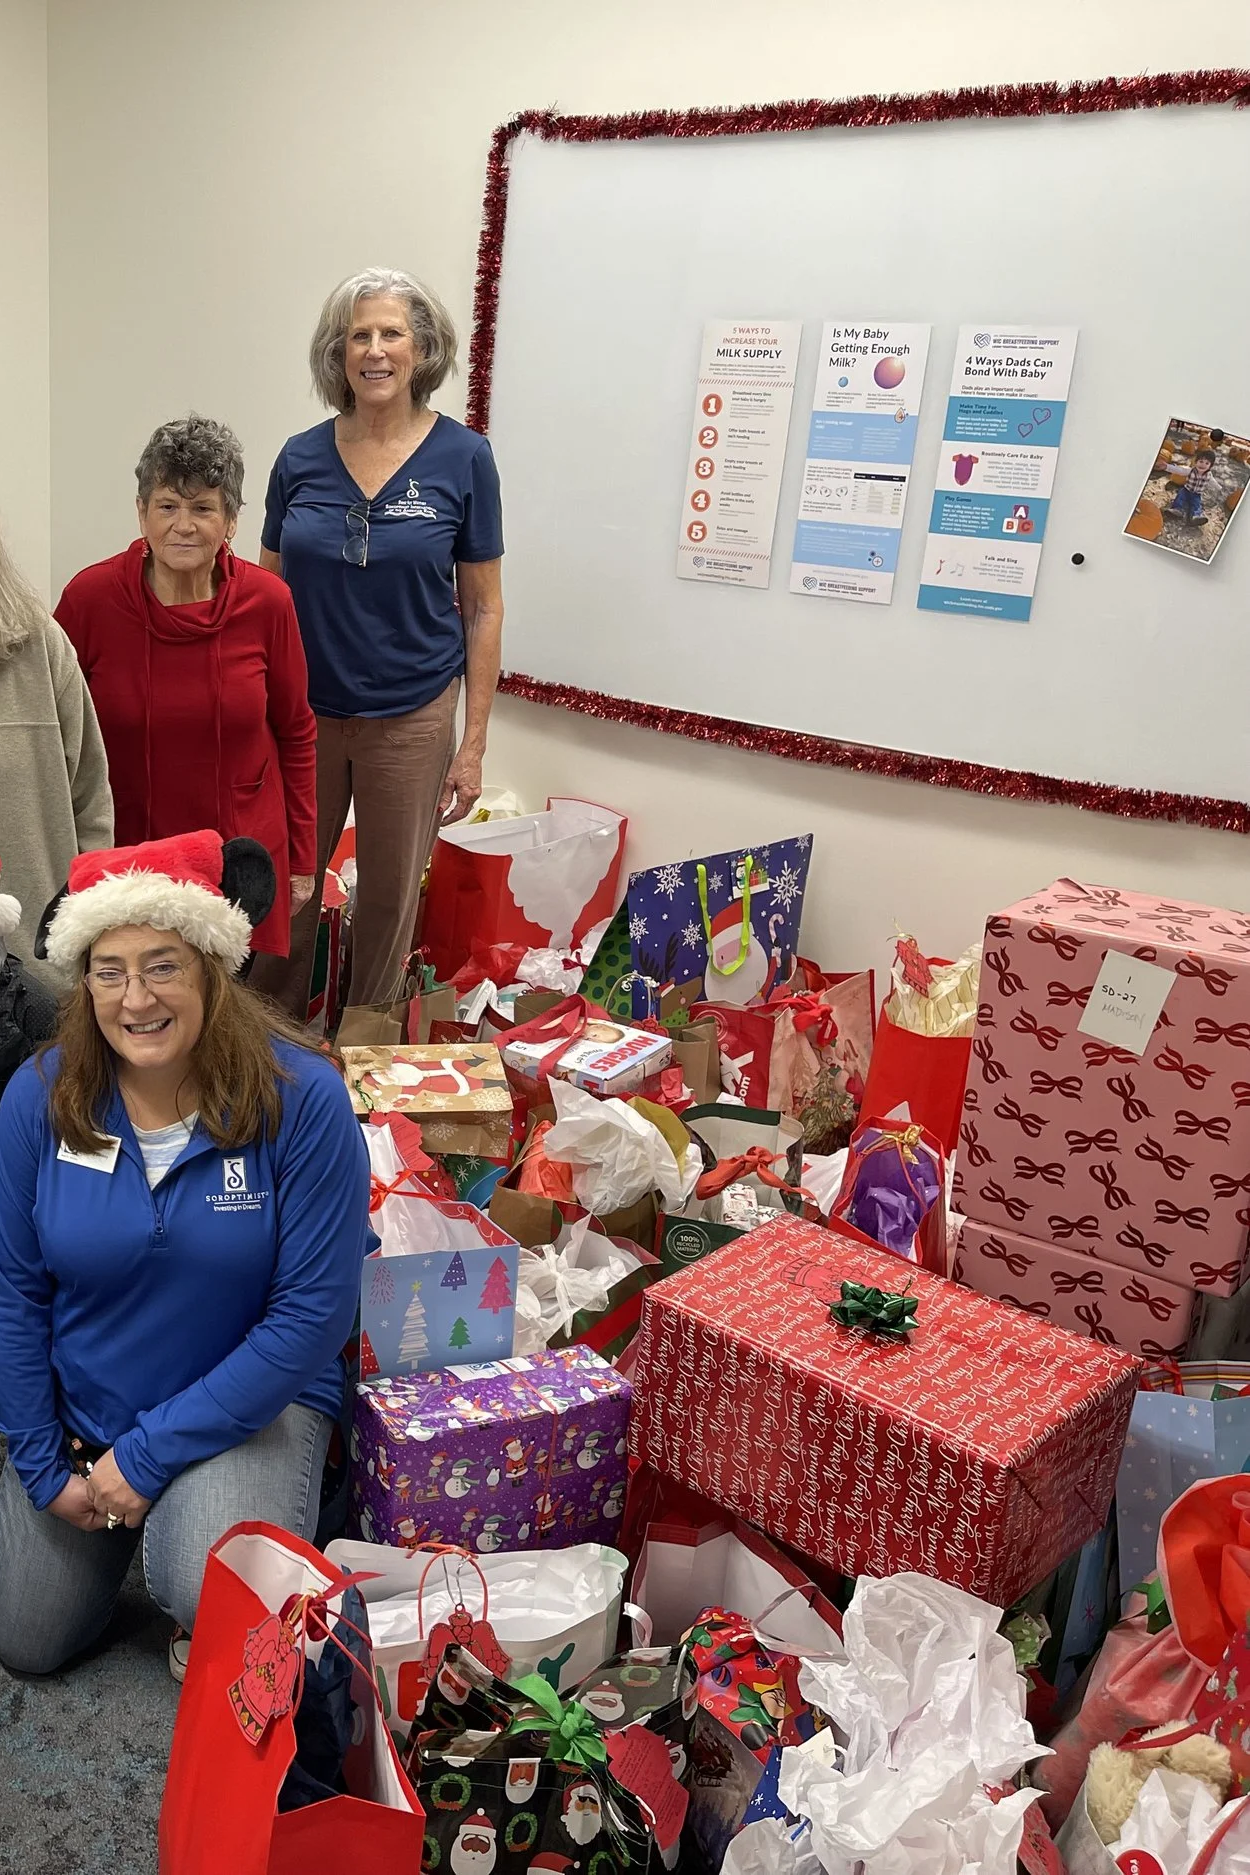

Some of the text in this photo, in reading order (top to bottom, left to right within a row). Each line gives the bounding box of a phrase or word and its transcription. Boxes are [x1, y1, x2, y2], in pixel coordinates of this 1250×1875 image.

[833, 328, 889, 340] Is My Baby
[716, 348, 782, 359] MILK SUPPLY
[831, 342, 910, 356] Getting Enough
[829, 357, 856, 367] Milk?
[966, 356, 1053, 368] 4 Ways Dads Can
[964, 367, 1046, 380] Bond With Baby
[707, 397, 716, 412] 1
[703, 430, 715, 445] 2
[698, 461, 711, 475] 3
[694, 493, 707, 508] 4
[1015, 506, 1027, 519] A
[691, 525, 704, 540] 5
[1006, 520, 1031, 532] B C
[589, 1035, 659, 1072] HUGGIES
[214, 1204, 237, 1212] Investing
[680, 1235, 699, 1243] 100%
